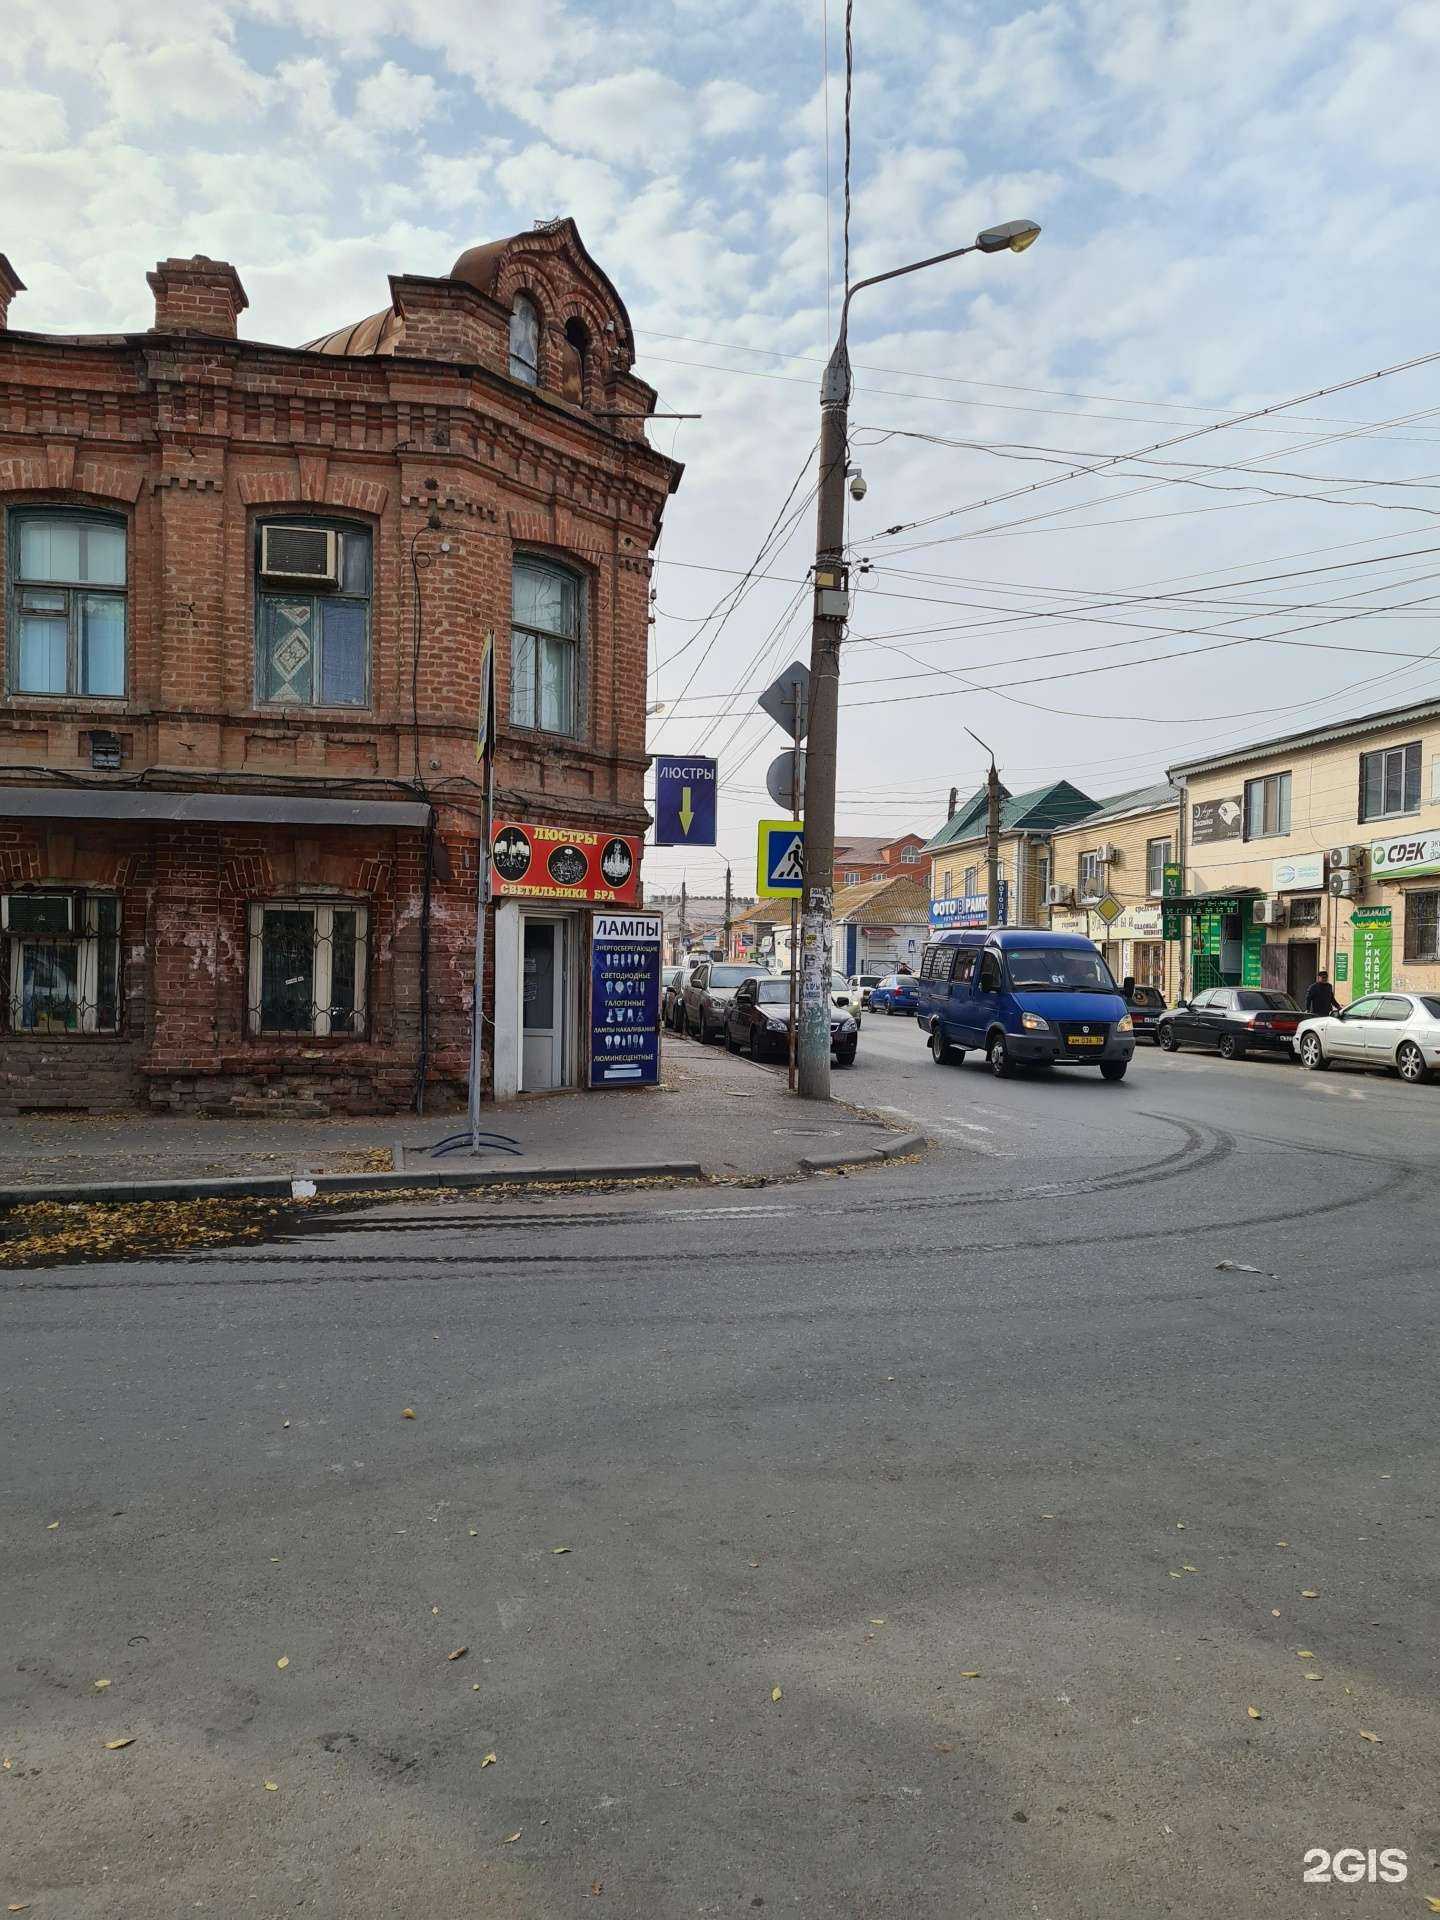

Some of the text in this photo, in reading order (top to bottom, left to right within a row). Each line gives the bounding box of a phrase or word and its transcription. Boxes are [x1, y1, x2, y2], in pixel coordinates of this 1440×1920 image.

[660, 766, 714, 780] ЛЮСТРЫ
[533, 827, 598, 846] ЛЮСТРЫ
[1387, 841, 1427, 864] CDEK
[500, 883, 616, 900] СВЕТИЛЬНИКИ БРА
[932, 900, 956, 916] ФОТО
[965, 896, 988, 914] РАМК
[596, 920, 659, 937] ЛАМПЫ
[594, 944, 658, 953] ЭНЕРГОСБЕРЕГАЮЩИЕ
[1364, 933, 1373, 996] ЮРИДИЧЕС
[600, 972, 651, 980] СВЕТОДИОДНЫЕ
[593, 1054, 654, 1062] ЛЮМИНЕСЦЕНТНЫЕ
